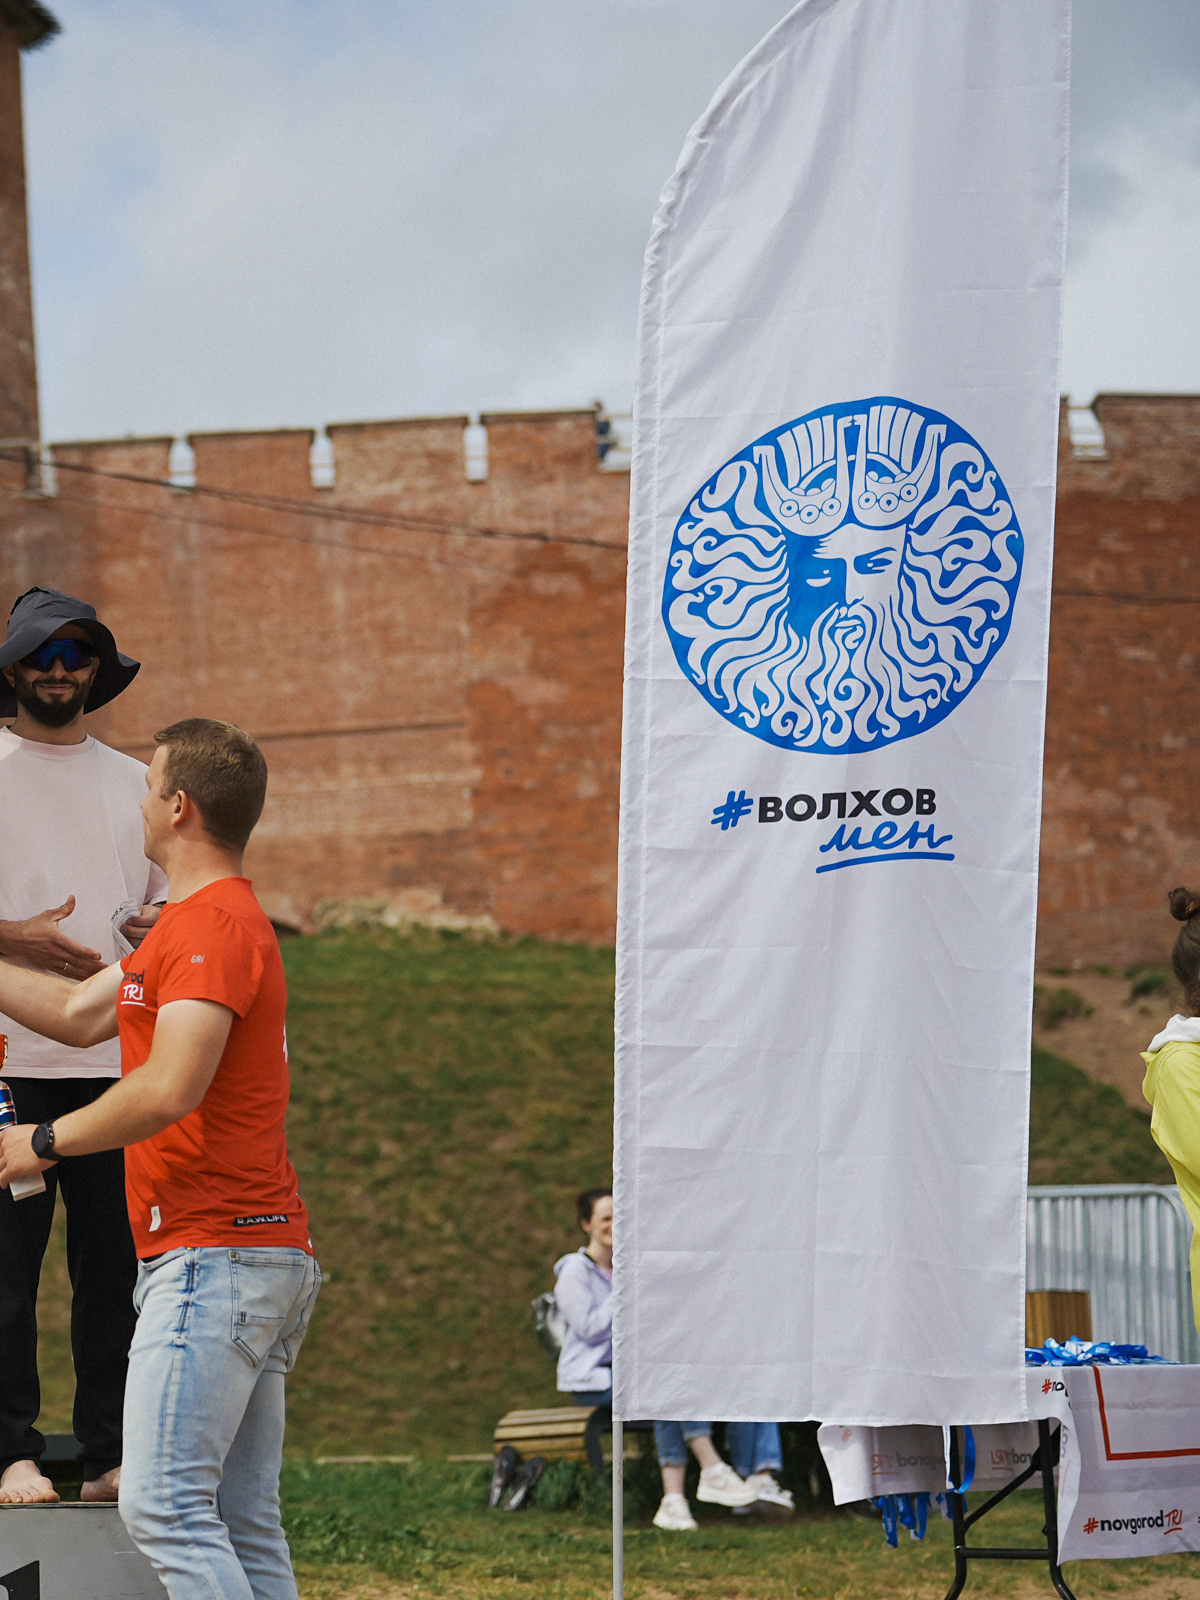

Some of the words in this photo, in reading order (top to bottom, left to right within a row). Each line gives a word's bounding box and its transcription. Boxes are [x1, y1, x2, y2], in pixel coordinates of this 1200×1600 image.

[710, 787, 937, 831] #ВОЛХОВ
[818, 820, 954, 853] мен
[122, 983, 144, 1001] TRI
